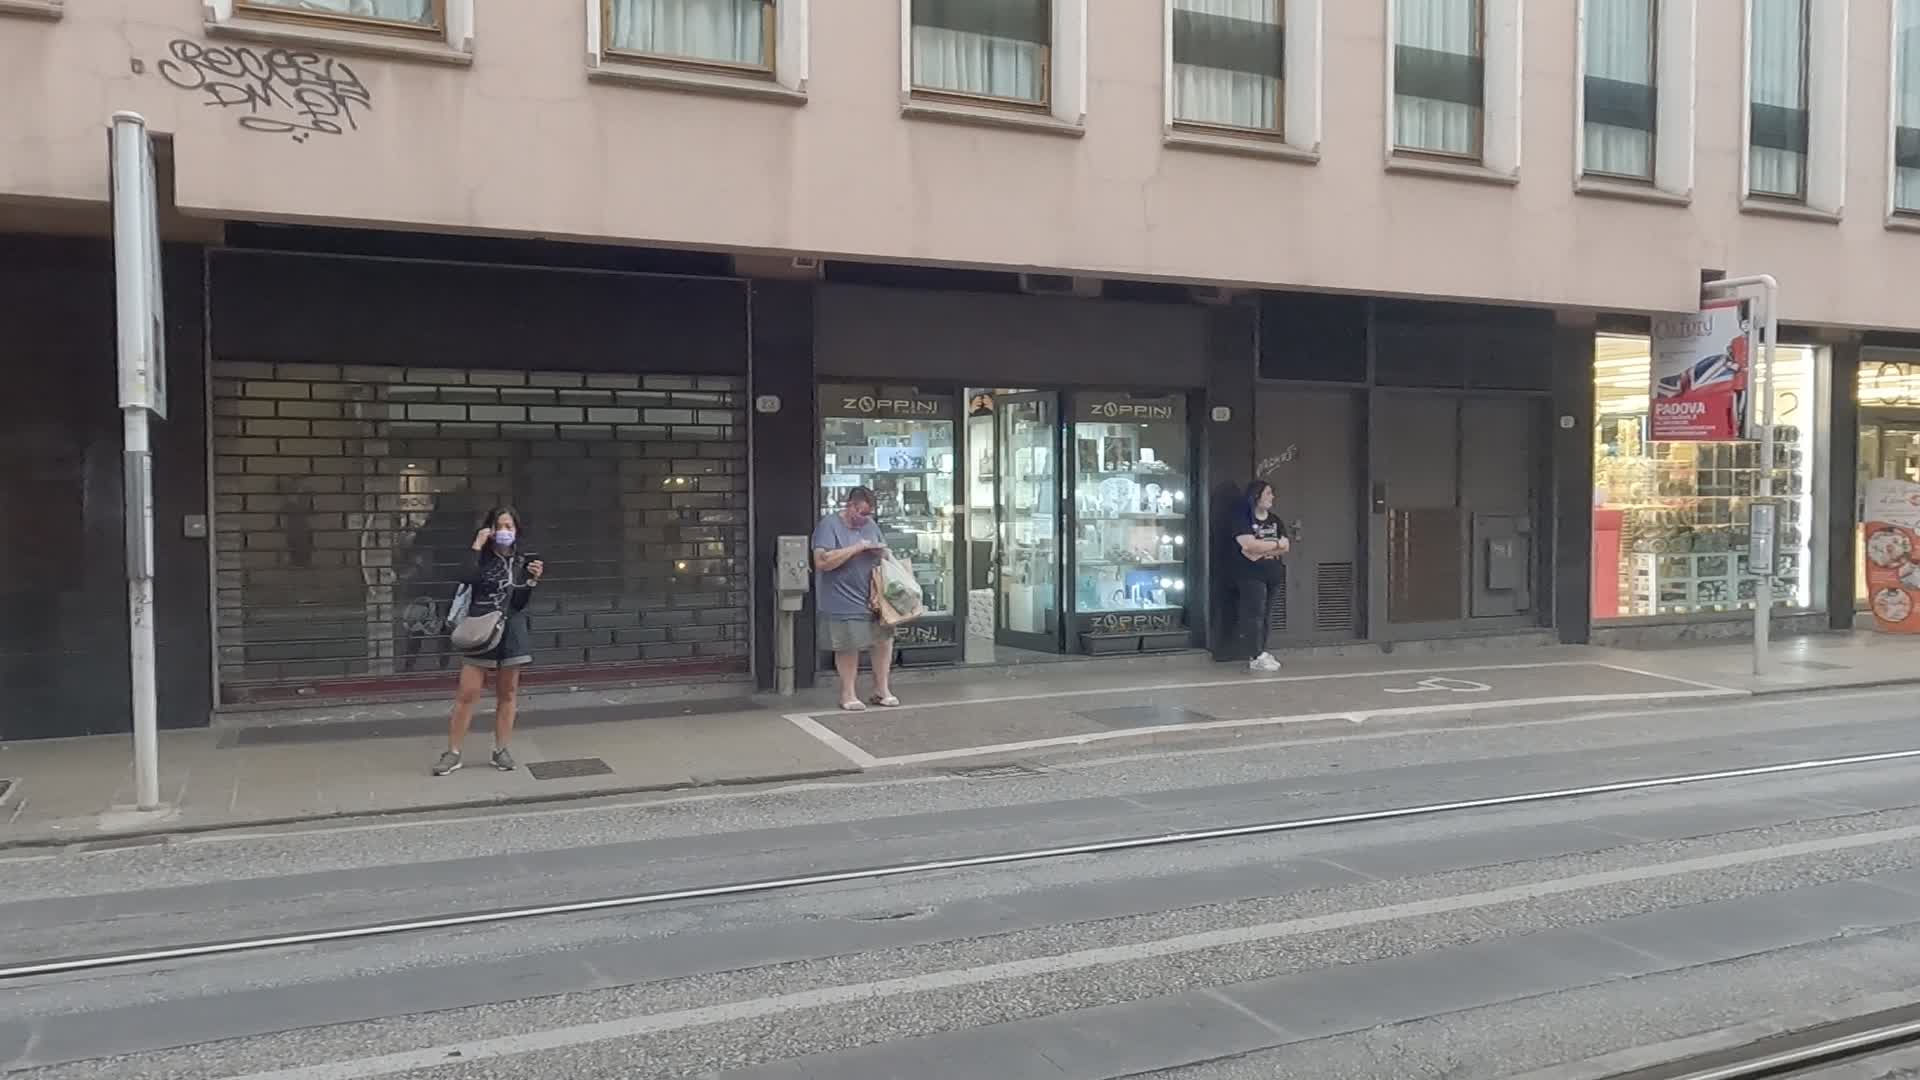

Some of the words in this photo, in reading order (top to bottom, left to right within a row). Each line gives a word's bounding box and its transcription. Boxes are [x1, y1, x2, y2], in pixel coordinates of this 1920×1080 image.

[842, 396, 938, 413] ZOPPINI
[1090, 401, 1173, 418] ZOPPINI
[1655, 402, 1706, 415] PADOVA
[1090, 613, 1171, 628] ZOPPINI
